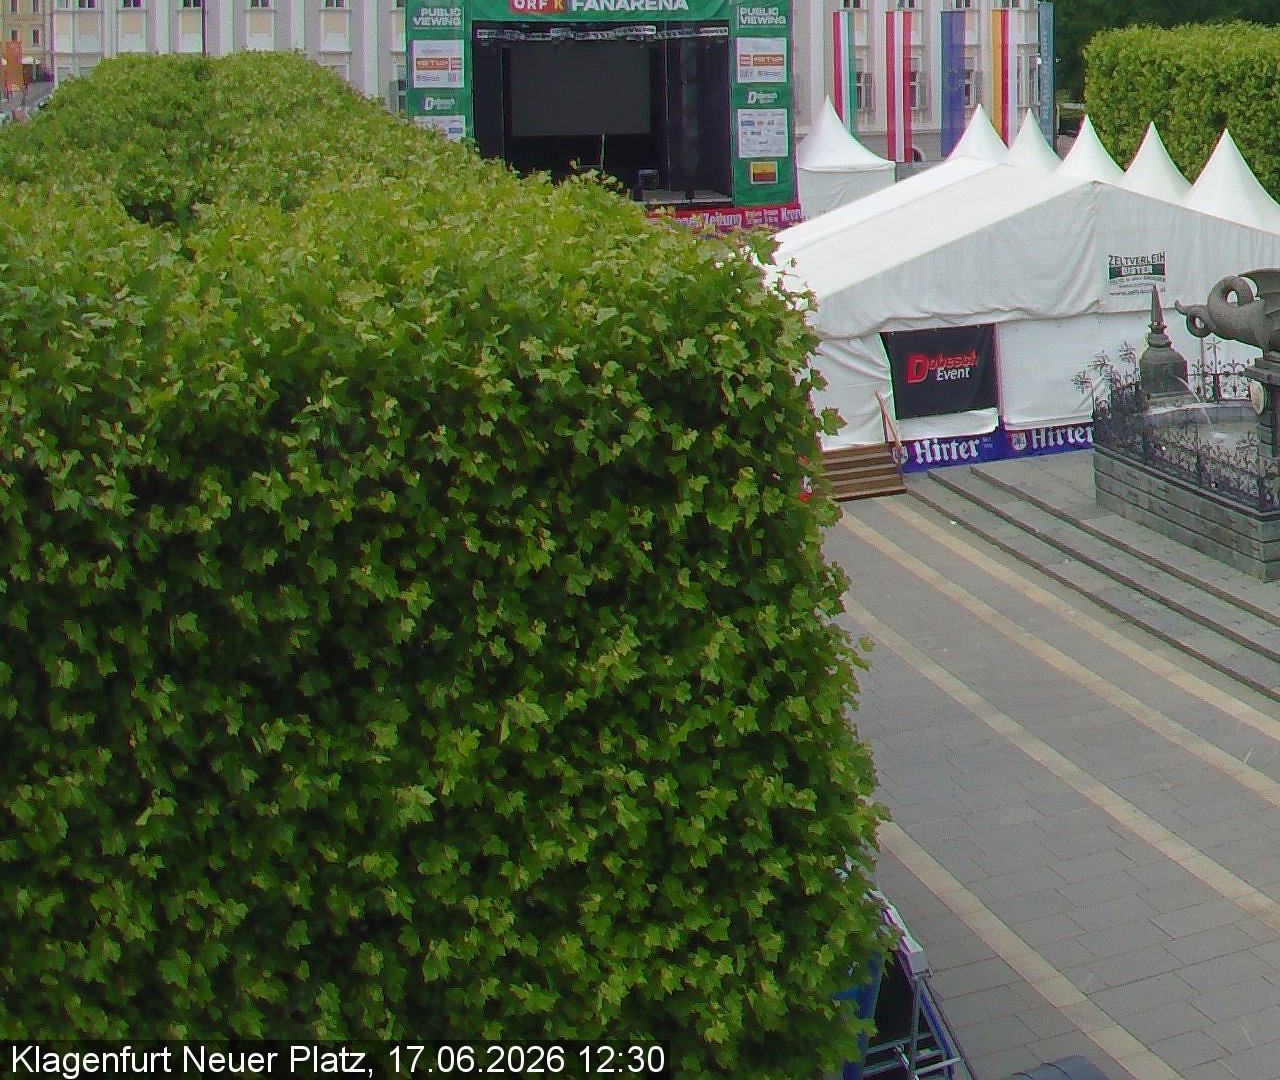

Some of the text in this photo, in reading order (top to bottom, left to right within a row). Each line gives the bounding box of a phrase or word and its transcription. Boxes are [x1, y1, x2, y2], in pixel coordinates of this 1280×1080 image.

[420, 7, 462, 17] PUBLIC
[740, 7, 779, 16] PUBLIC
[413, 16, 462, 26] VIEWING
[740, 15, 787, 25] VIEWING
[1108, 251, 1166, 267] ZELTVERLEIH
[936, 366, 971, 381] Event
[1031, 426, 1094, 449] Hirter
[916, 438, 980, 464] Hirter
